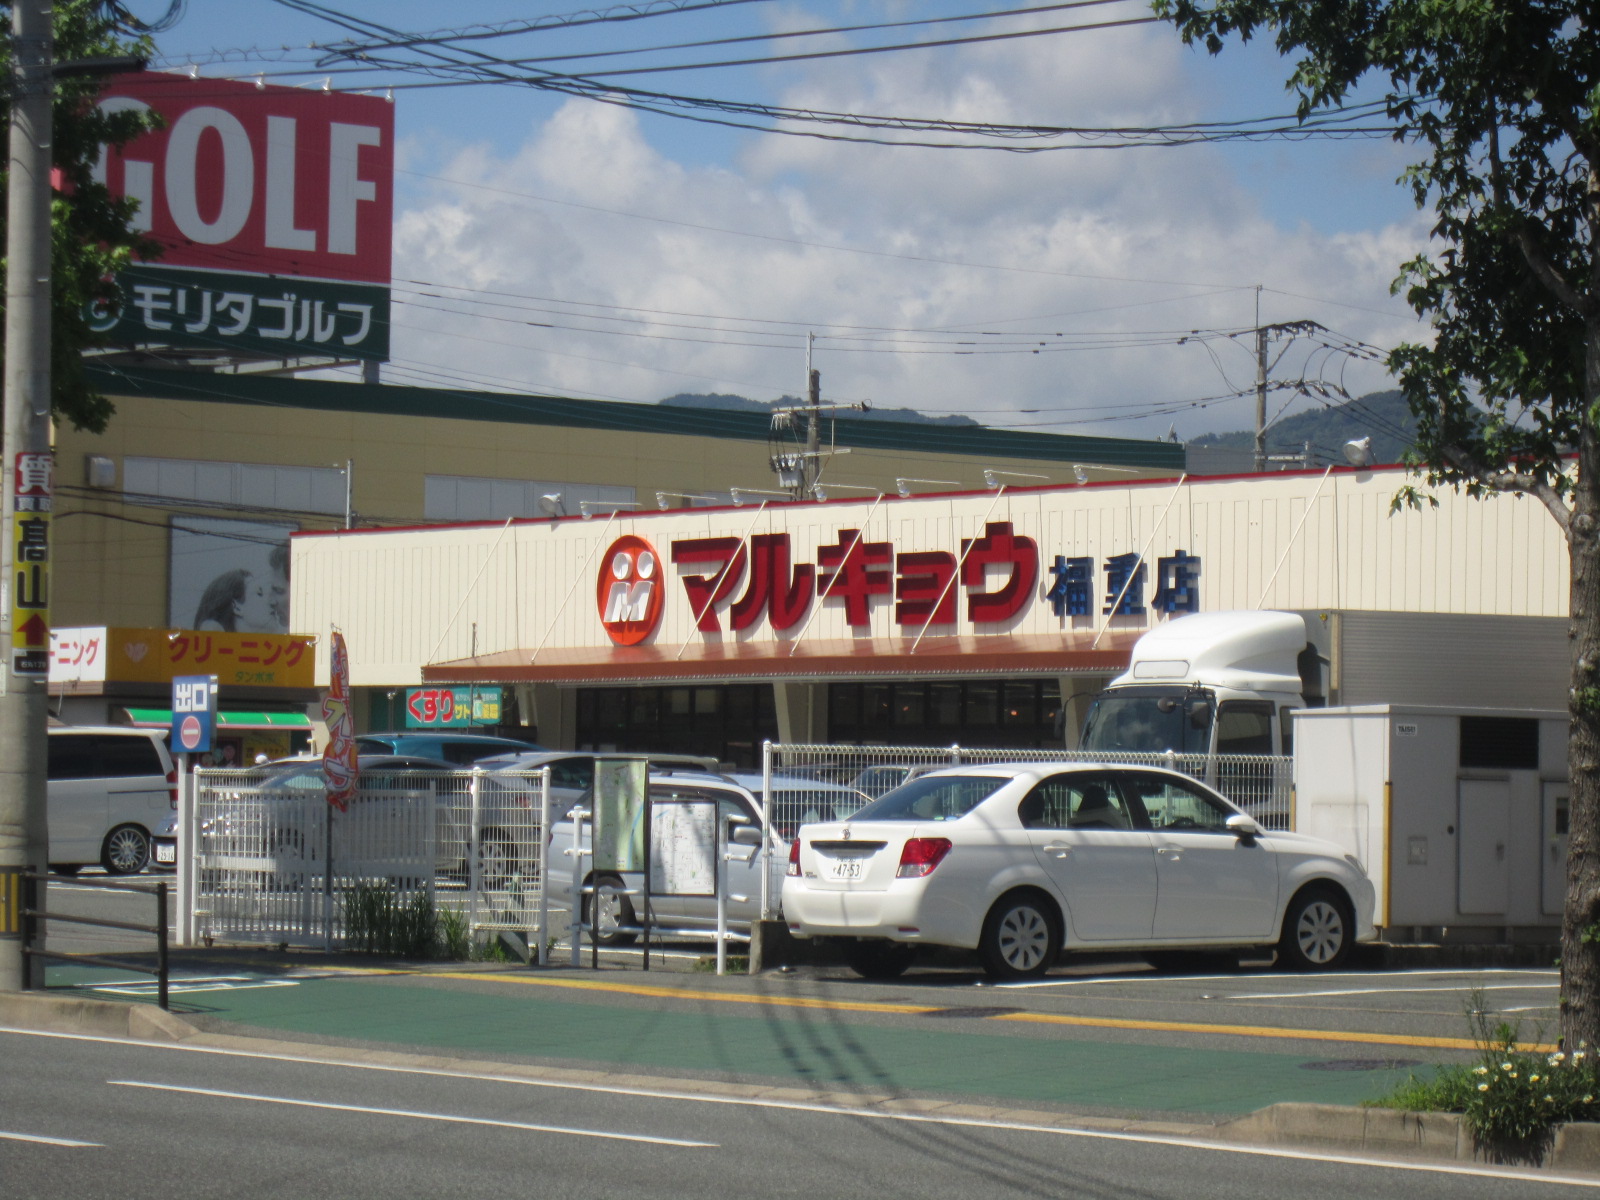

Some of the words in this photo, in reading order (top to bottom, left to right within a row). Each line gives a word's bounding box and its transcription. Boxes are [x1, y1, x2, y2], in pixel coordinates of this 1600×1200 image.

[91, 96, 381, 256] GOLF
[133, 285, 374, 346] モリタゴルフ
[18, 454, 50, 493] 質
[671, 521, 1039, 632] マルキョウ
[1046, 549, 1202, 617] 福重店
[168, 636, 307, 668] クリーニング
[176, 683, 208, 712] 出口
[408, 690, 455, 723] くすり
